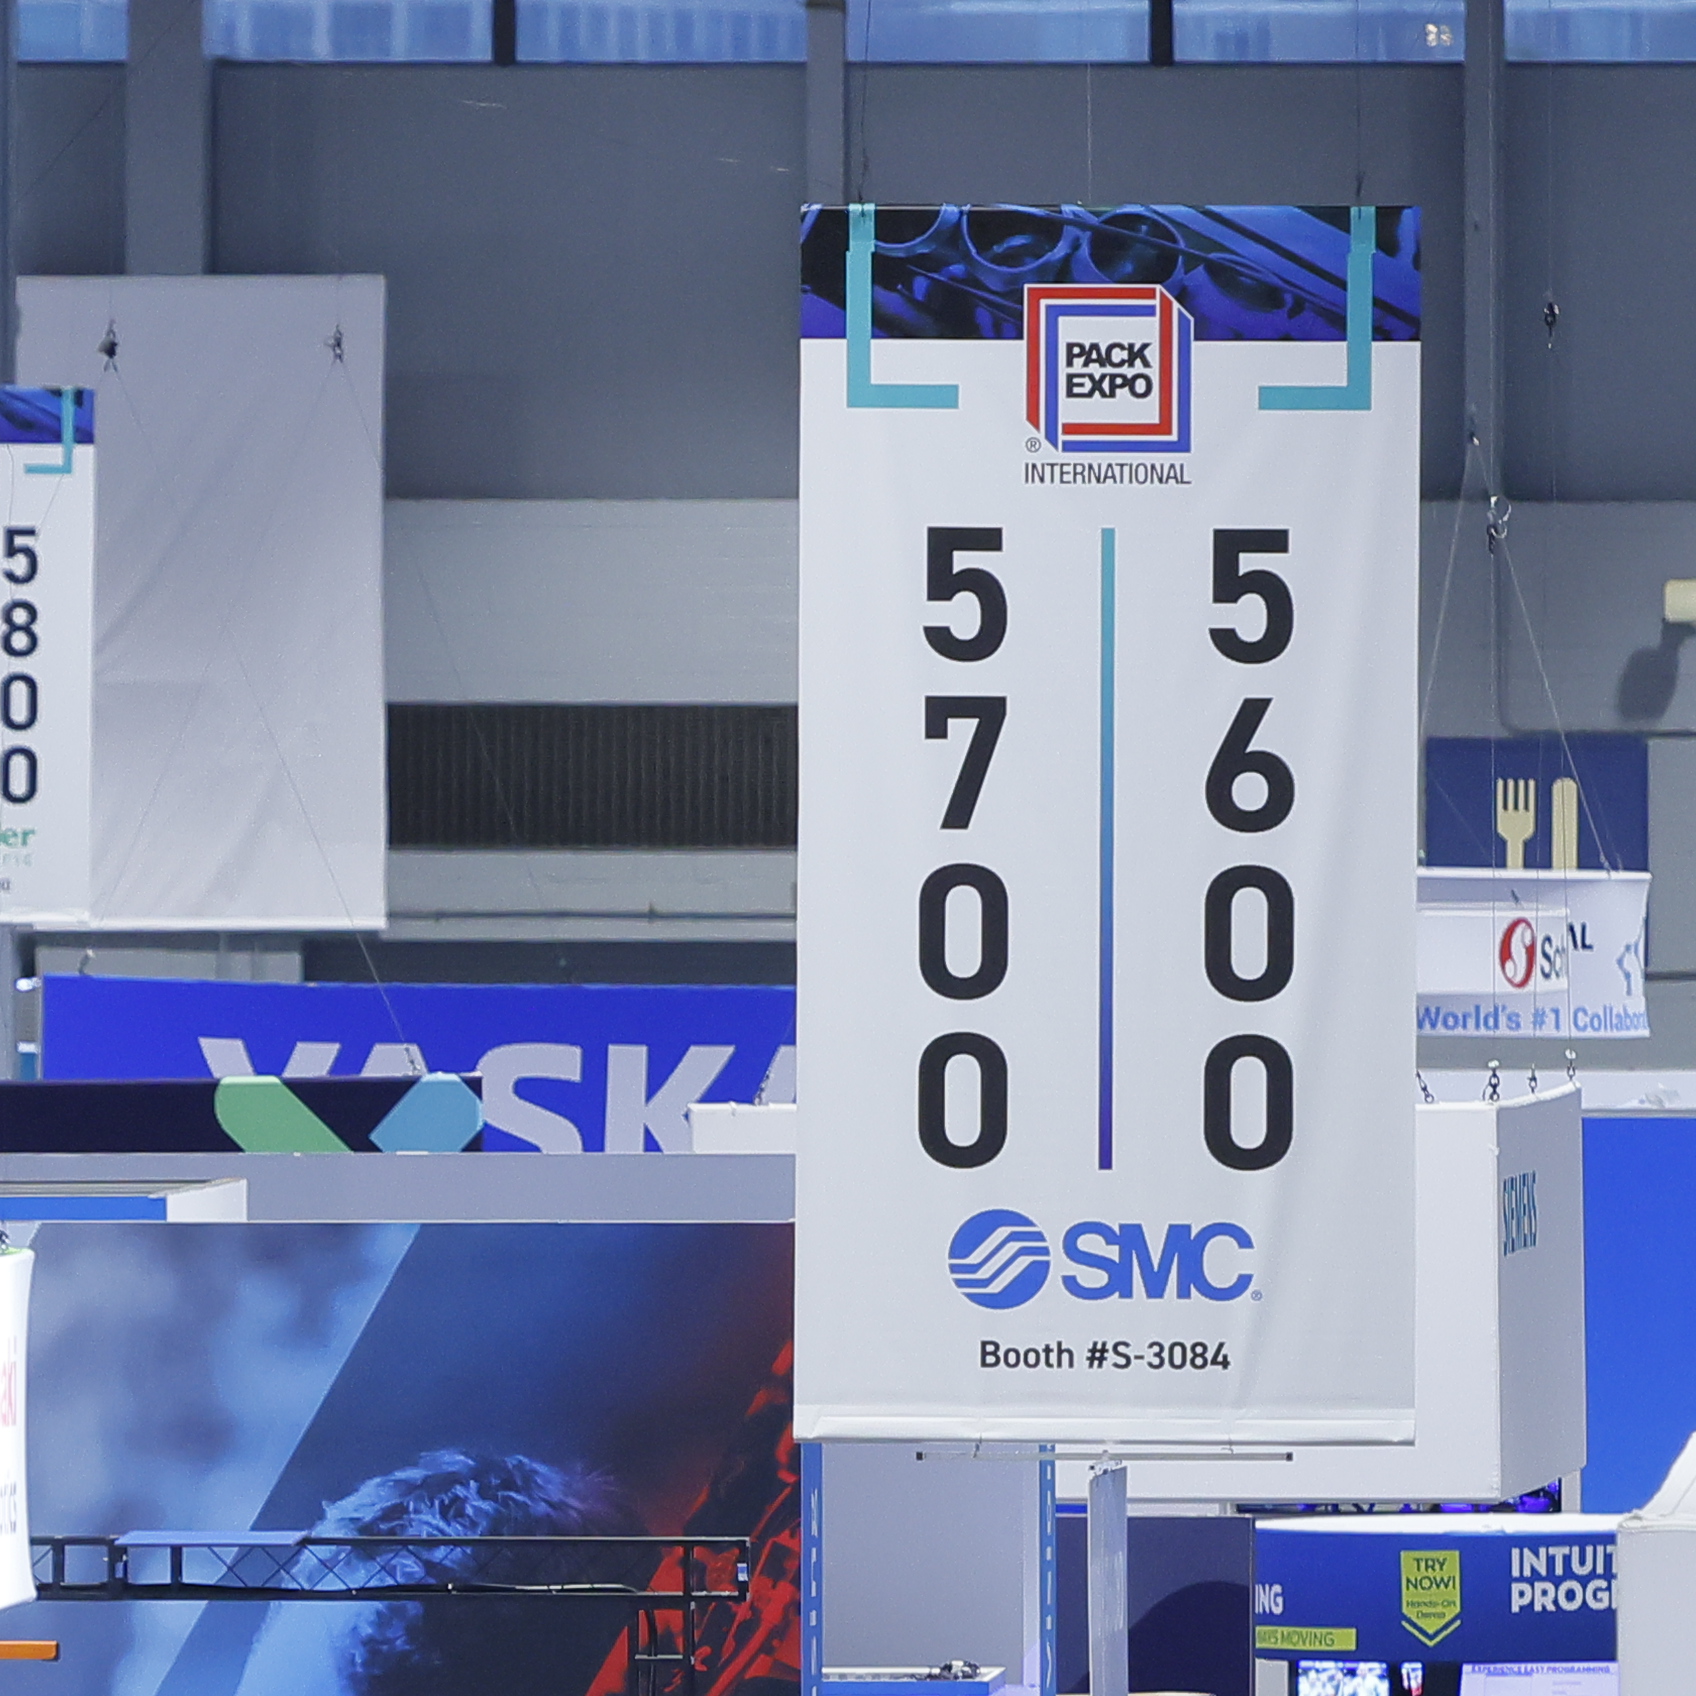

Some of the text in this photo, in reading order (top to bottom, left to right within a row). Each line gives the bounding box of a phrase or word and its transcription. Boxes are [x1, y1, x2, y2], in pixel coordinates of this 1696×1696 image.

[1065, 341, 1152, 368] PACK
[1065, 373, 1152, 399] EXPO
[1024, 462, 1192, 485] INTERNATIONAL
[1417, 1004, 1522, 1031] World's
[1533, 1007, 1562, 1032] #1
[1503, 1168, 1538, 1257] SIEMENS
[1061, 1221, 1255, 1301] SMC
[979, 1340, 1232, 1370] Booth #S-3084
[1413, 1557, 1447, 1573] TRY
[1406, 1576, 1456, 1592] NOW!
[1281, 1630, 1336, 1648] MOVING
